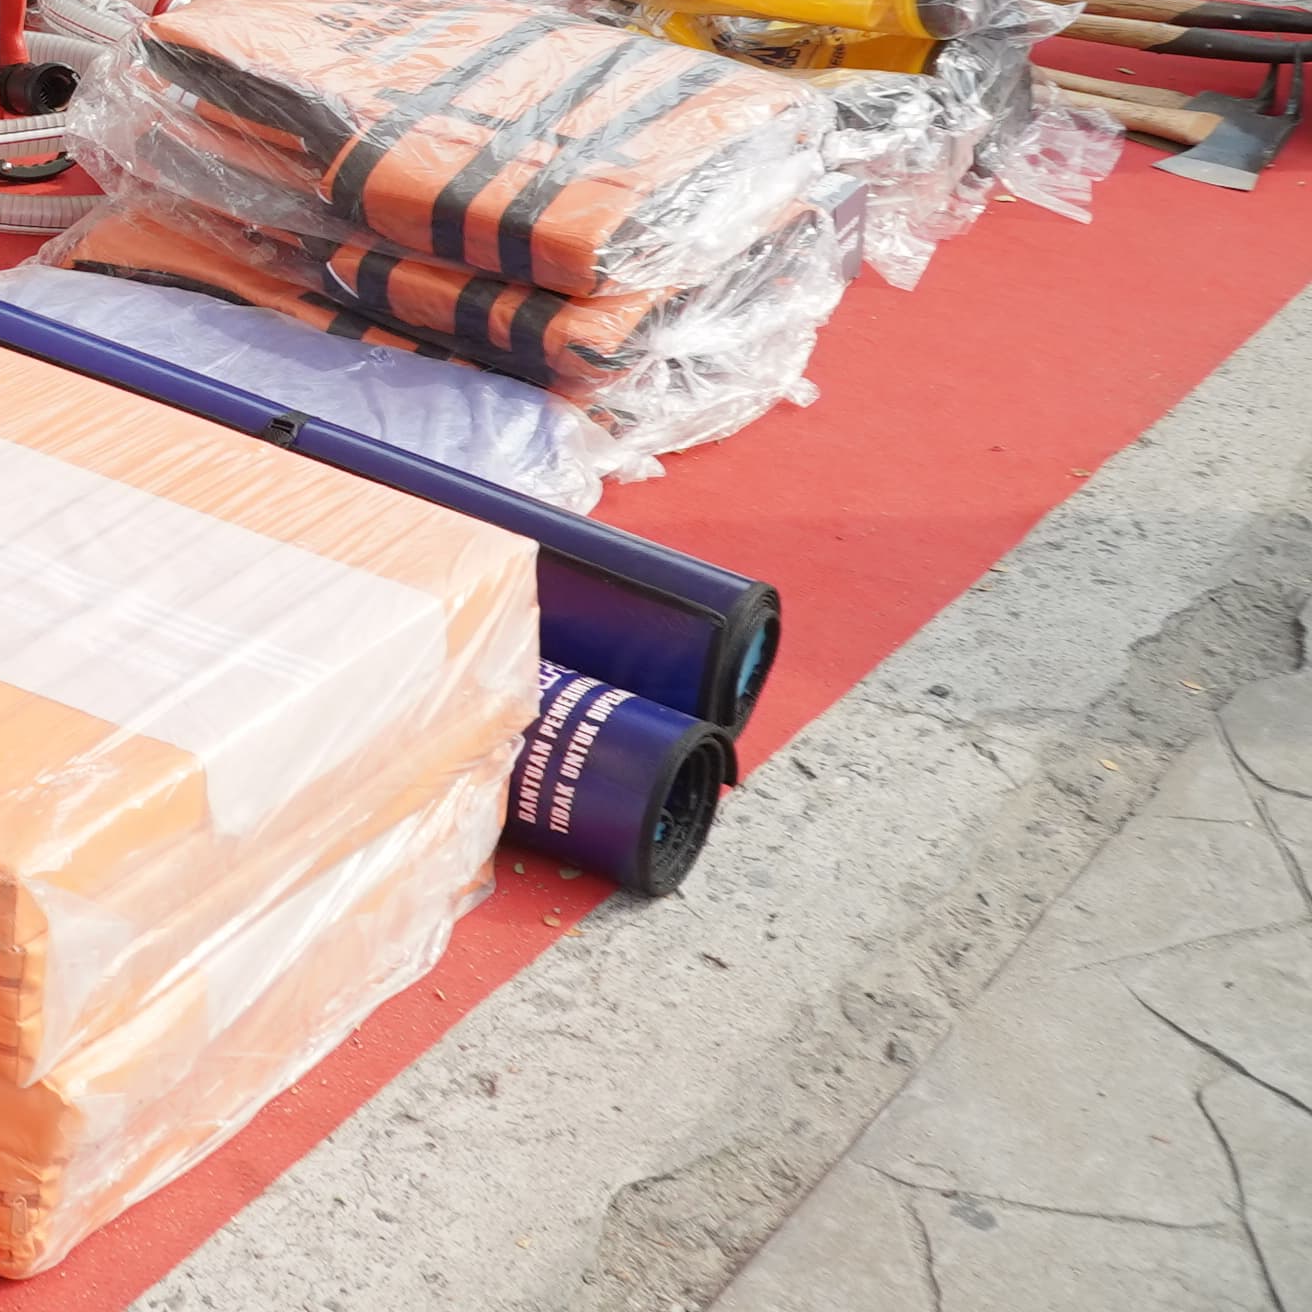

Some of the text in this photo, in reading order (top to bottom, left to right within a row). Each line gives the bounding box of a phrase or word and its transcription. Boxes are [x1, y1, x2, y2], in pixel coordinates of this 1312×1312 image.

[559, 720, 601, 781] UNTUK
[518, 739, 553, 825] BANTUAN
[550, 782, 575, 835] TIDAK
